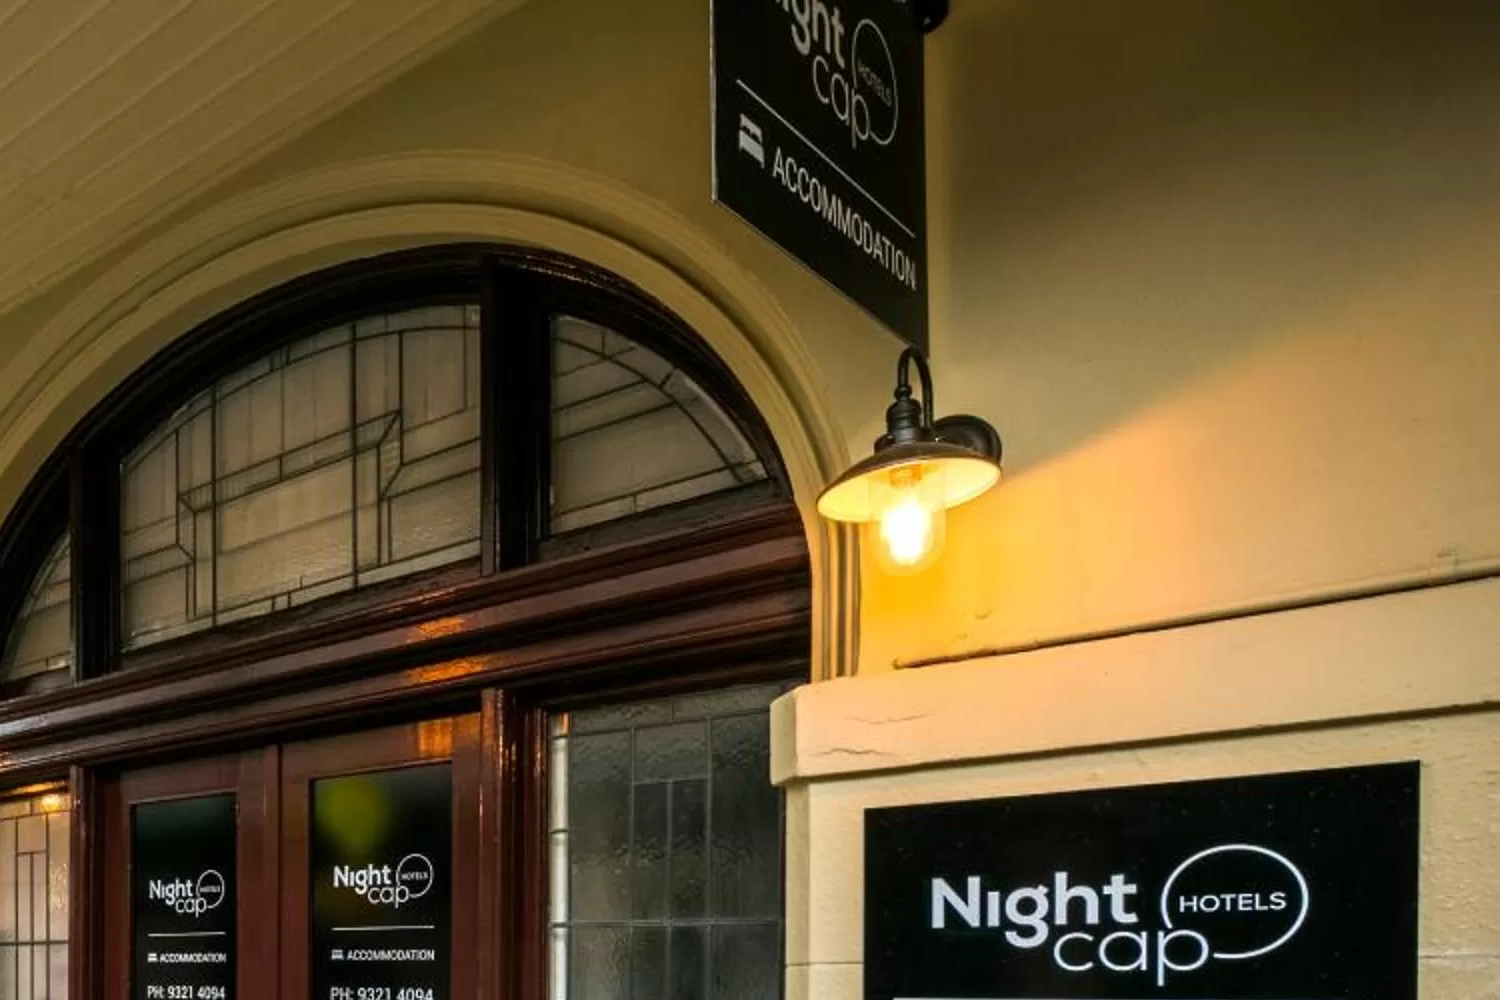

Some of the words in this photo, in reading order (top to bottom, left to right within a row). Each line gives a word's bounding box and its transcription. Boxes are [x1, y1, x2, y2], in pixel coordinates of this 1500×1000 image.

[857, 59, 892, 108] HOTELS
[812, 55, 870, 149] cap
[772, 146, 916, 291] ACCOMMODATION
[149, 878, 193, 905] Night
[332, 863, 392, 895] Night
[175, 897, 207, 918] cap
[367, 885, 409, 908] cap
[931, 871, 1139, 949] Night
[1179, 891, 1287, 913] HOTELS
[347, 949, 435, 961] ACCOMMODATION
[1053, 929, 1209, 987] cap
[167, 985, 193, 1000] 9321
[197, 986, 226, 1000] 4094
